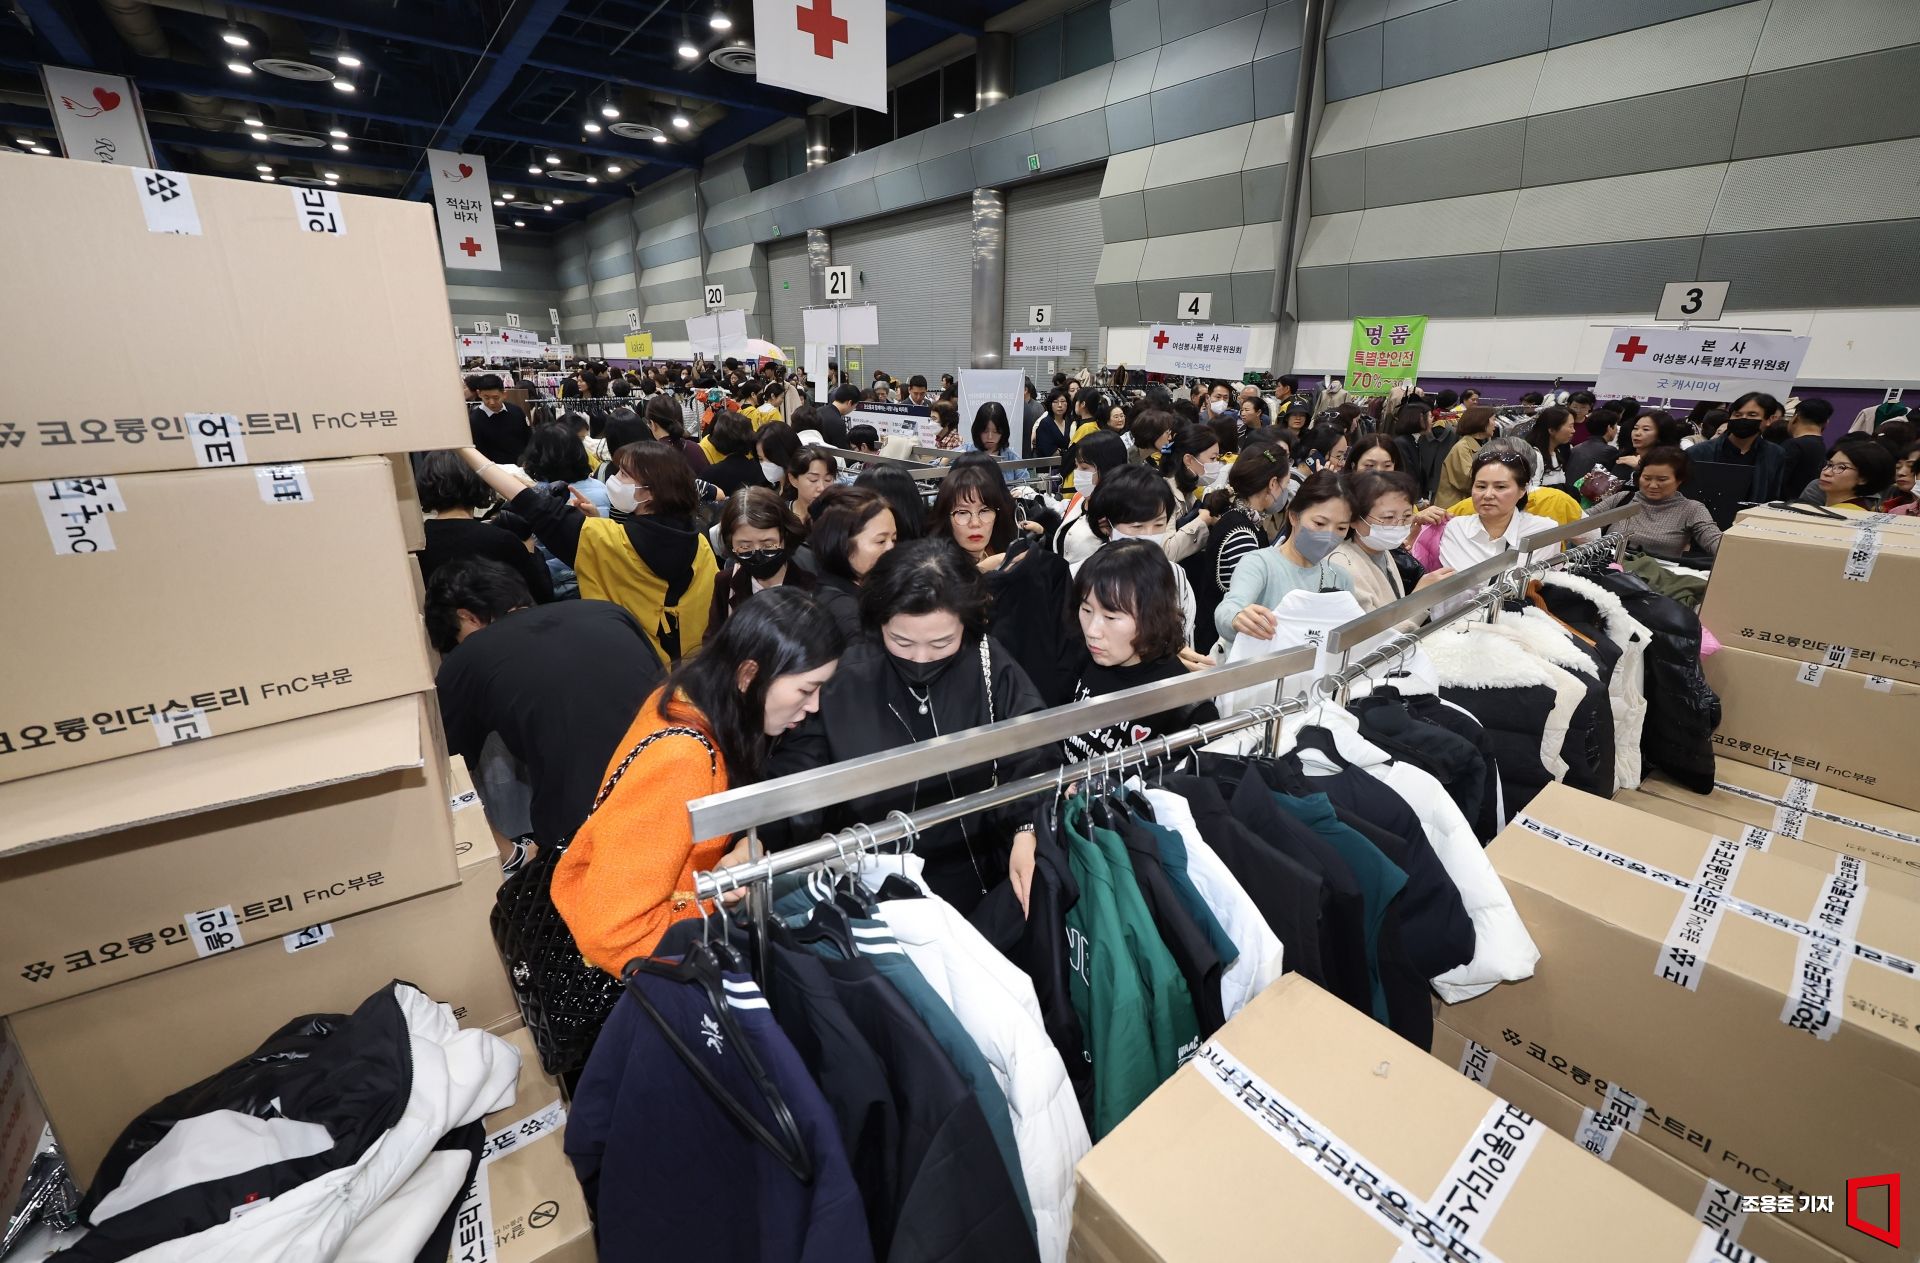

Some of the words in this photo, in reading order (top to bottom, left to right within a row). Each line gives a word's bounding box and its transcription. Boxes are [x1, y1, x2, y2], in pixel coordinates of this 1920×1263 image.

[446, 197, 483, 213] 적십자
[453, 210, 479, 224] 바자
[830, 271, 847, 294] 21
[708, 288, 722, 304] 20
[1680, 287, 1704, 314] 3
[1187, 296, 1200, 316] 4
[508, 315, 518, 326] 17
[628, 312, 637, 328] 19
[1036, 308, 1044, 323] 5
[1196, 332, 1204, 342] 본
[1210, 333, 1220, 343] 사
[1366, 325, 1383, 346] 명
[1388, 325, 1411, 346] 품
[1172, 342, 1243, 355] 여성봉사특별자문위원회
[1700, 339, 1716, 353] 본
[1729, 341, 1747, 355] 사
[1355, 351, 1414, 368] 특별할인전
[1652, 352, 1791, 373] 여성봉사특별자문위원회
[1656, 378, 1669, 389] 굿
[1674, 379, 1721, 393] 캐시미어
[311, 409, 399, 431] FnC부문
[0, 686, 250, 756] 오롱인더스트리
[260, 667, 354, 700] FnC부문
[1825, 765, 1877, 787] FnC부문
[303, 870, 385, 907] FnC부문
